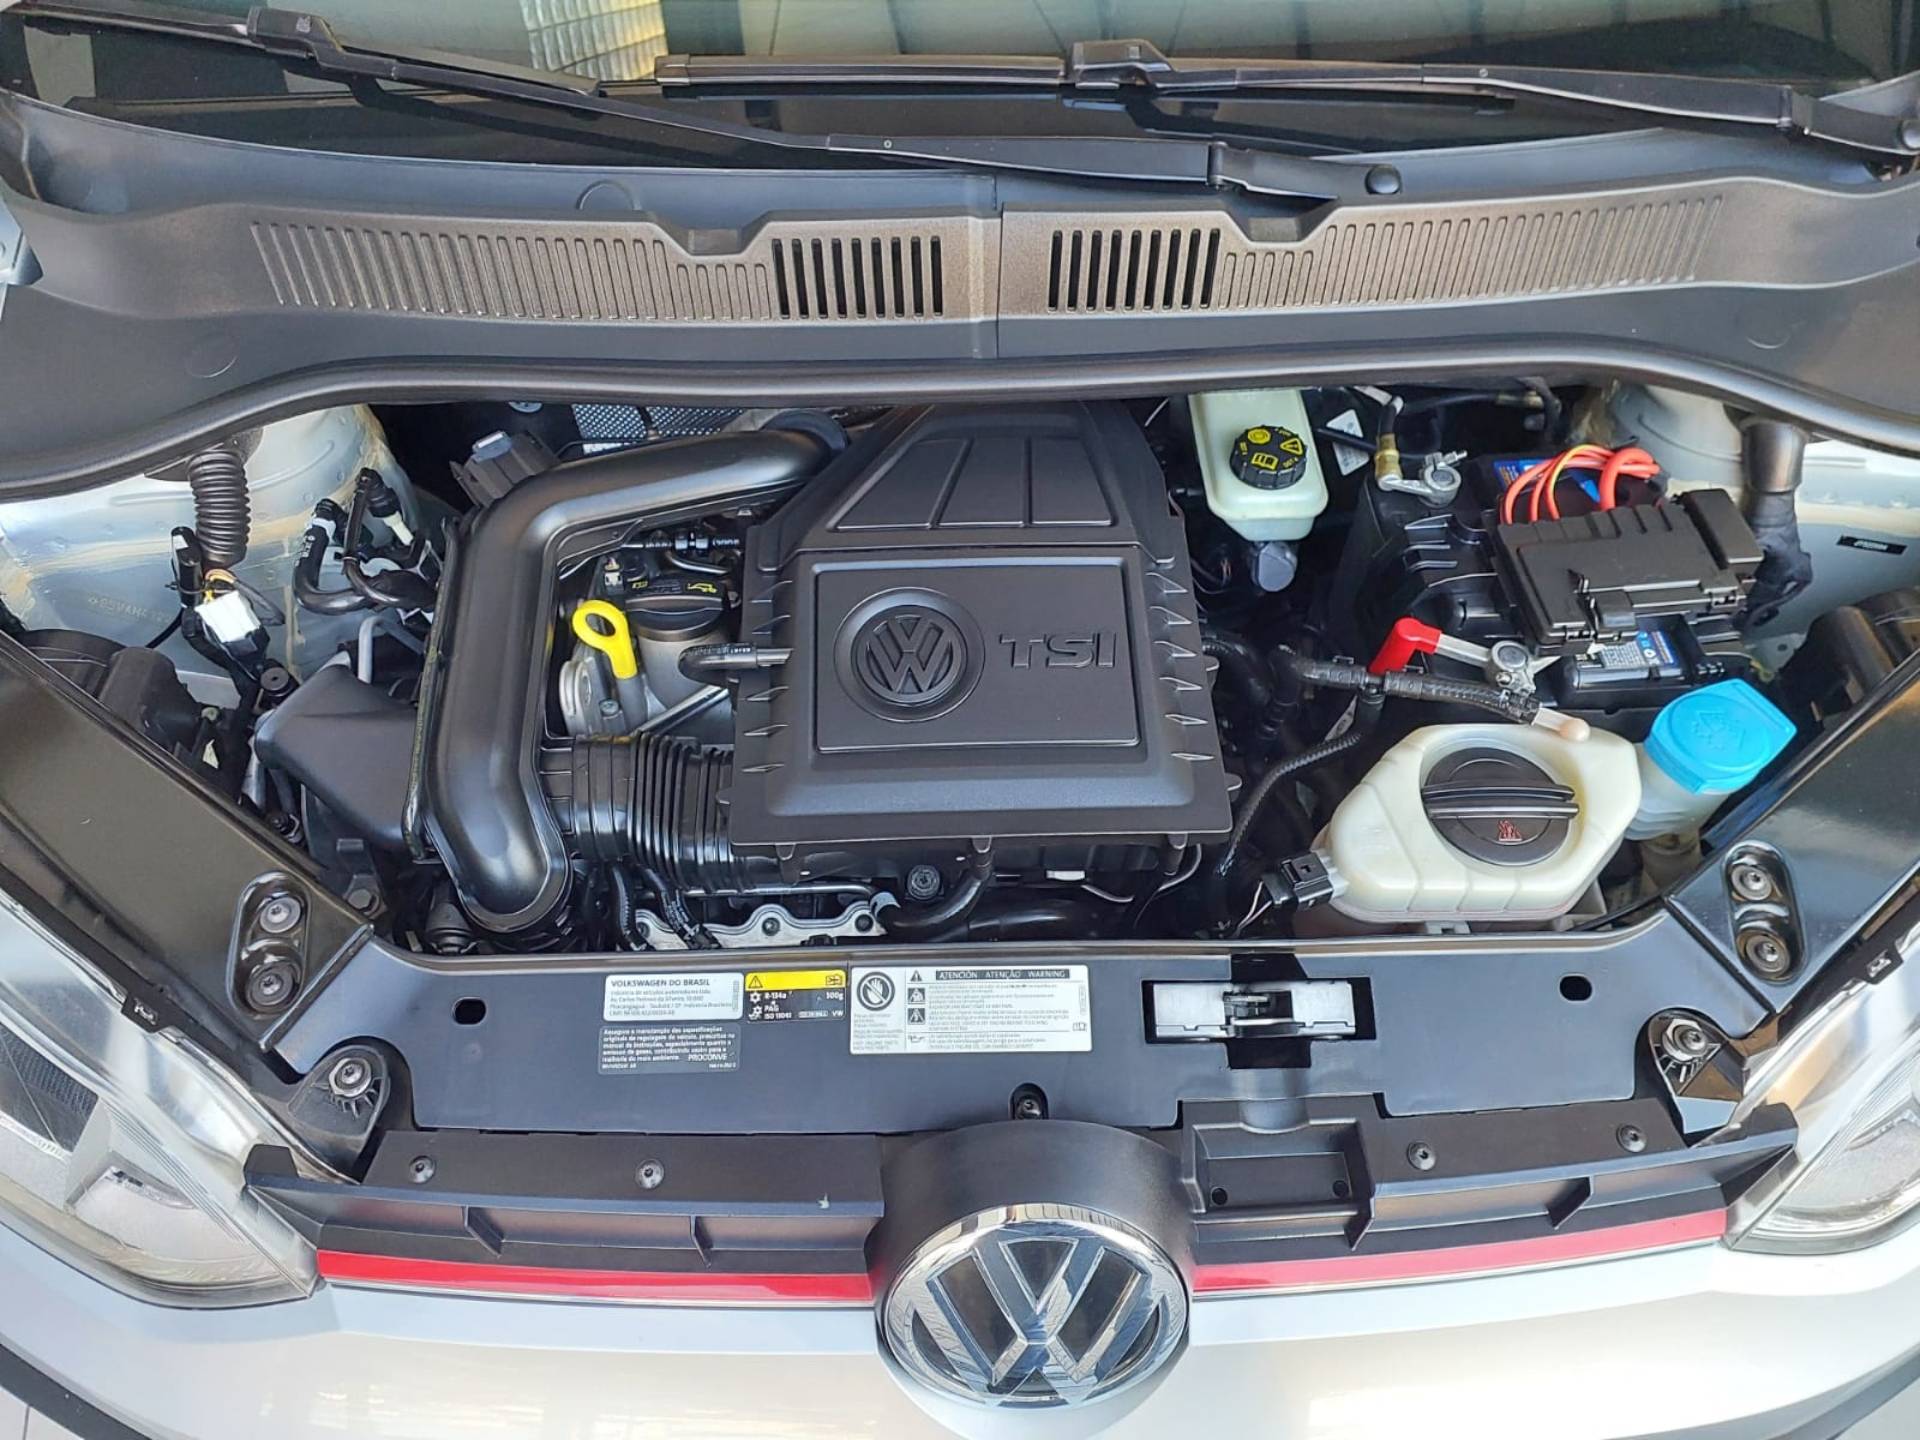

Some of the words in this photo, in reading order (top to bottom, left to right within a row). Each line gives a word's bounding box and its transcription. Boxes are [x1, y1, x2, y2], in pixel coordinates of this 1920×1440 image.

[999, 633, 1116, 670] TSI
[940, 970, 978, 979] ATENCIÓN
[985, 968, 1021, 980] ATENÇÃO
[1028, 970, 1065, 979] WARNING
[611, 979, 667, 987] VOLKSWAGEN
[669, 979, 681, 987] DO
